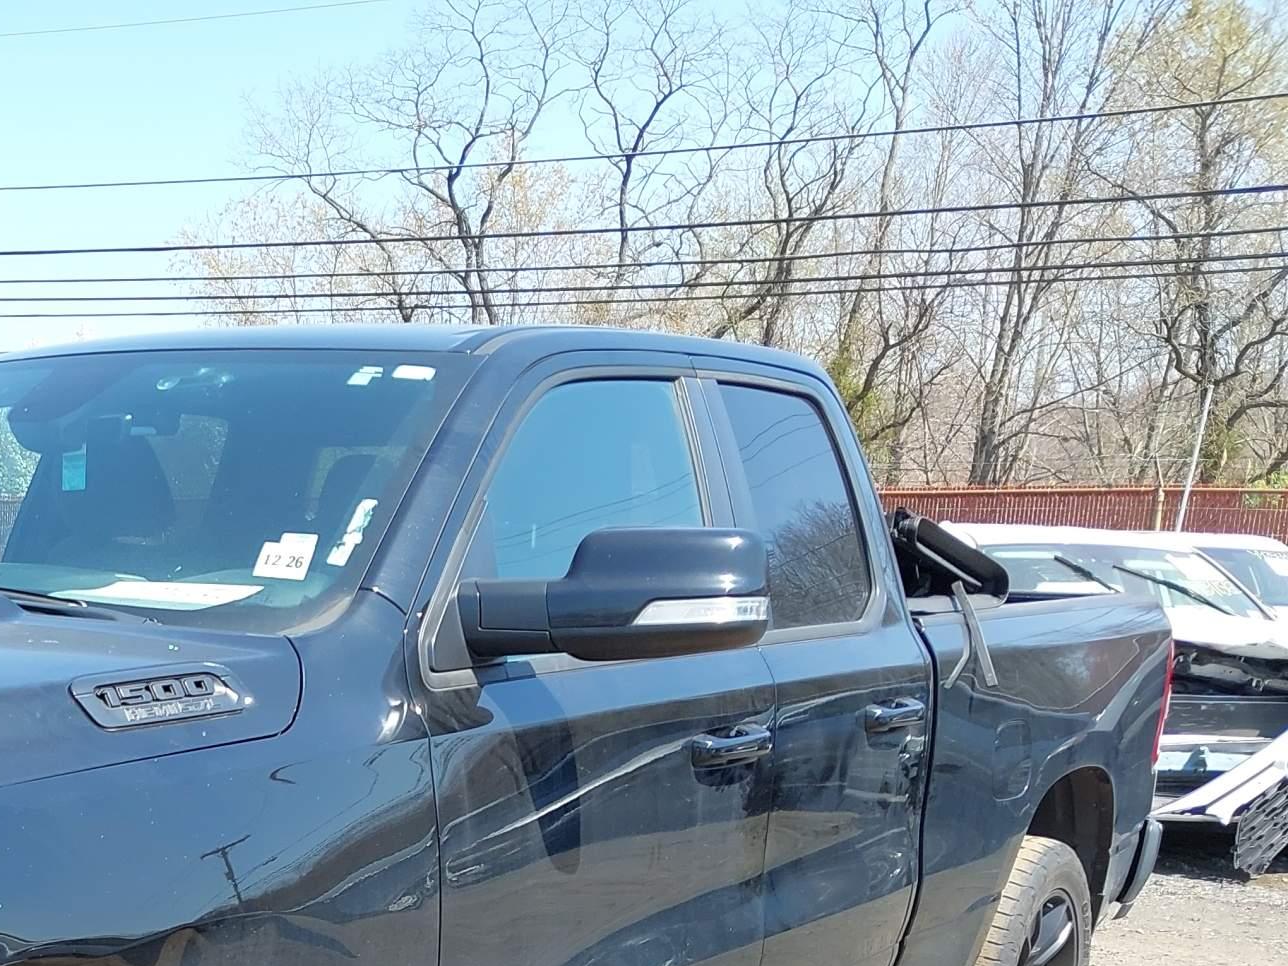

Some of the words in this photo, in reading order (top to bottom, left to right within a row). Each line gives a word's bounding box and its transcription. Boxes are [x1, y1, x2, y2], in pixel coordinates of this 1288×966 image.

[264, 554, 281, 566] 12
[285, 555, 304, 569] 26
[96, 675, 215, 708] 1500
